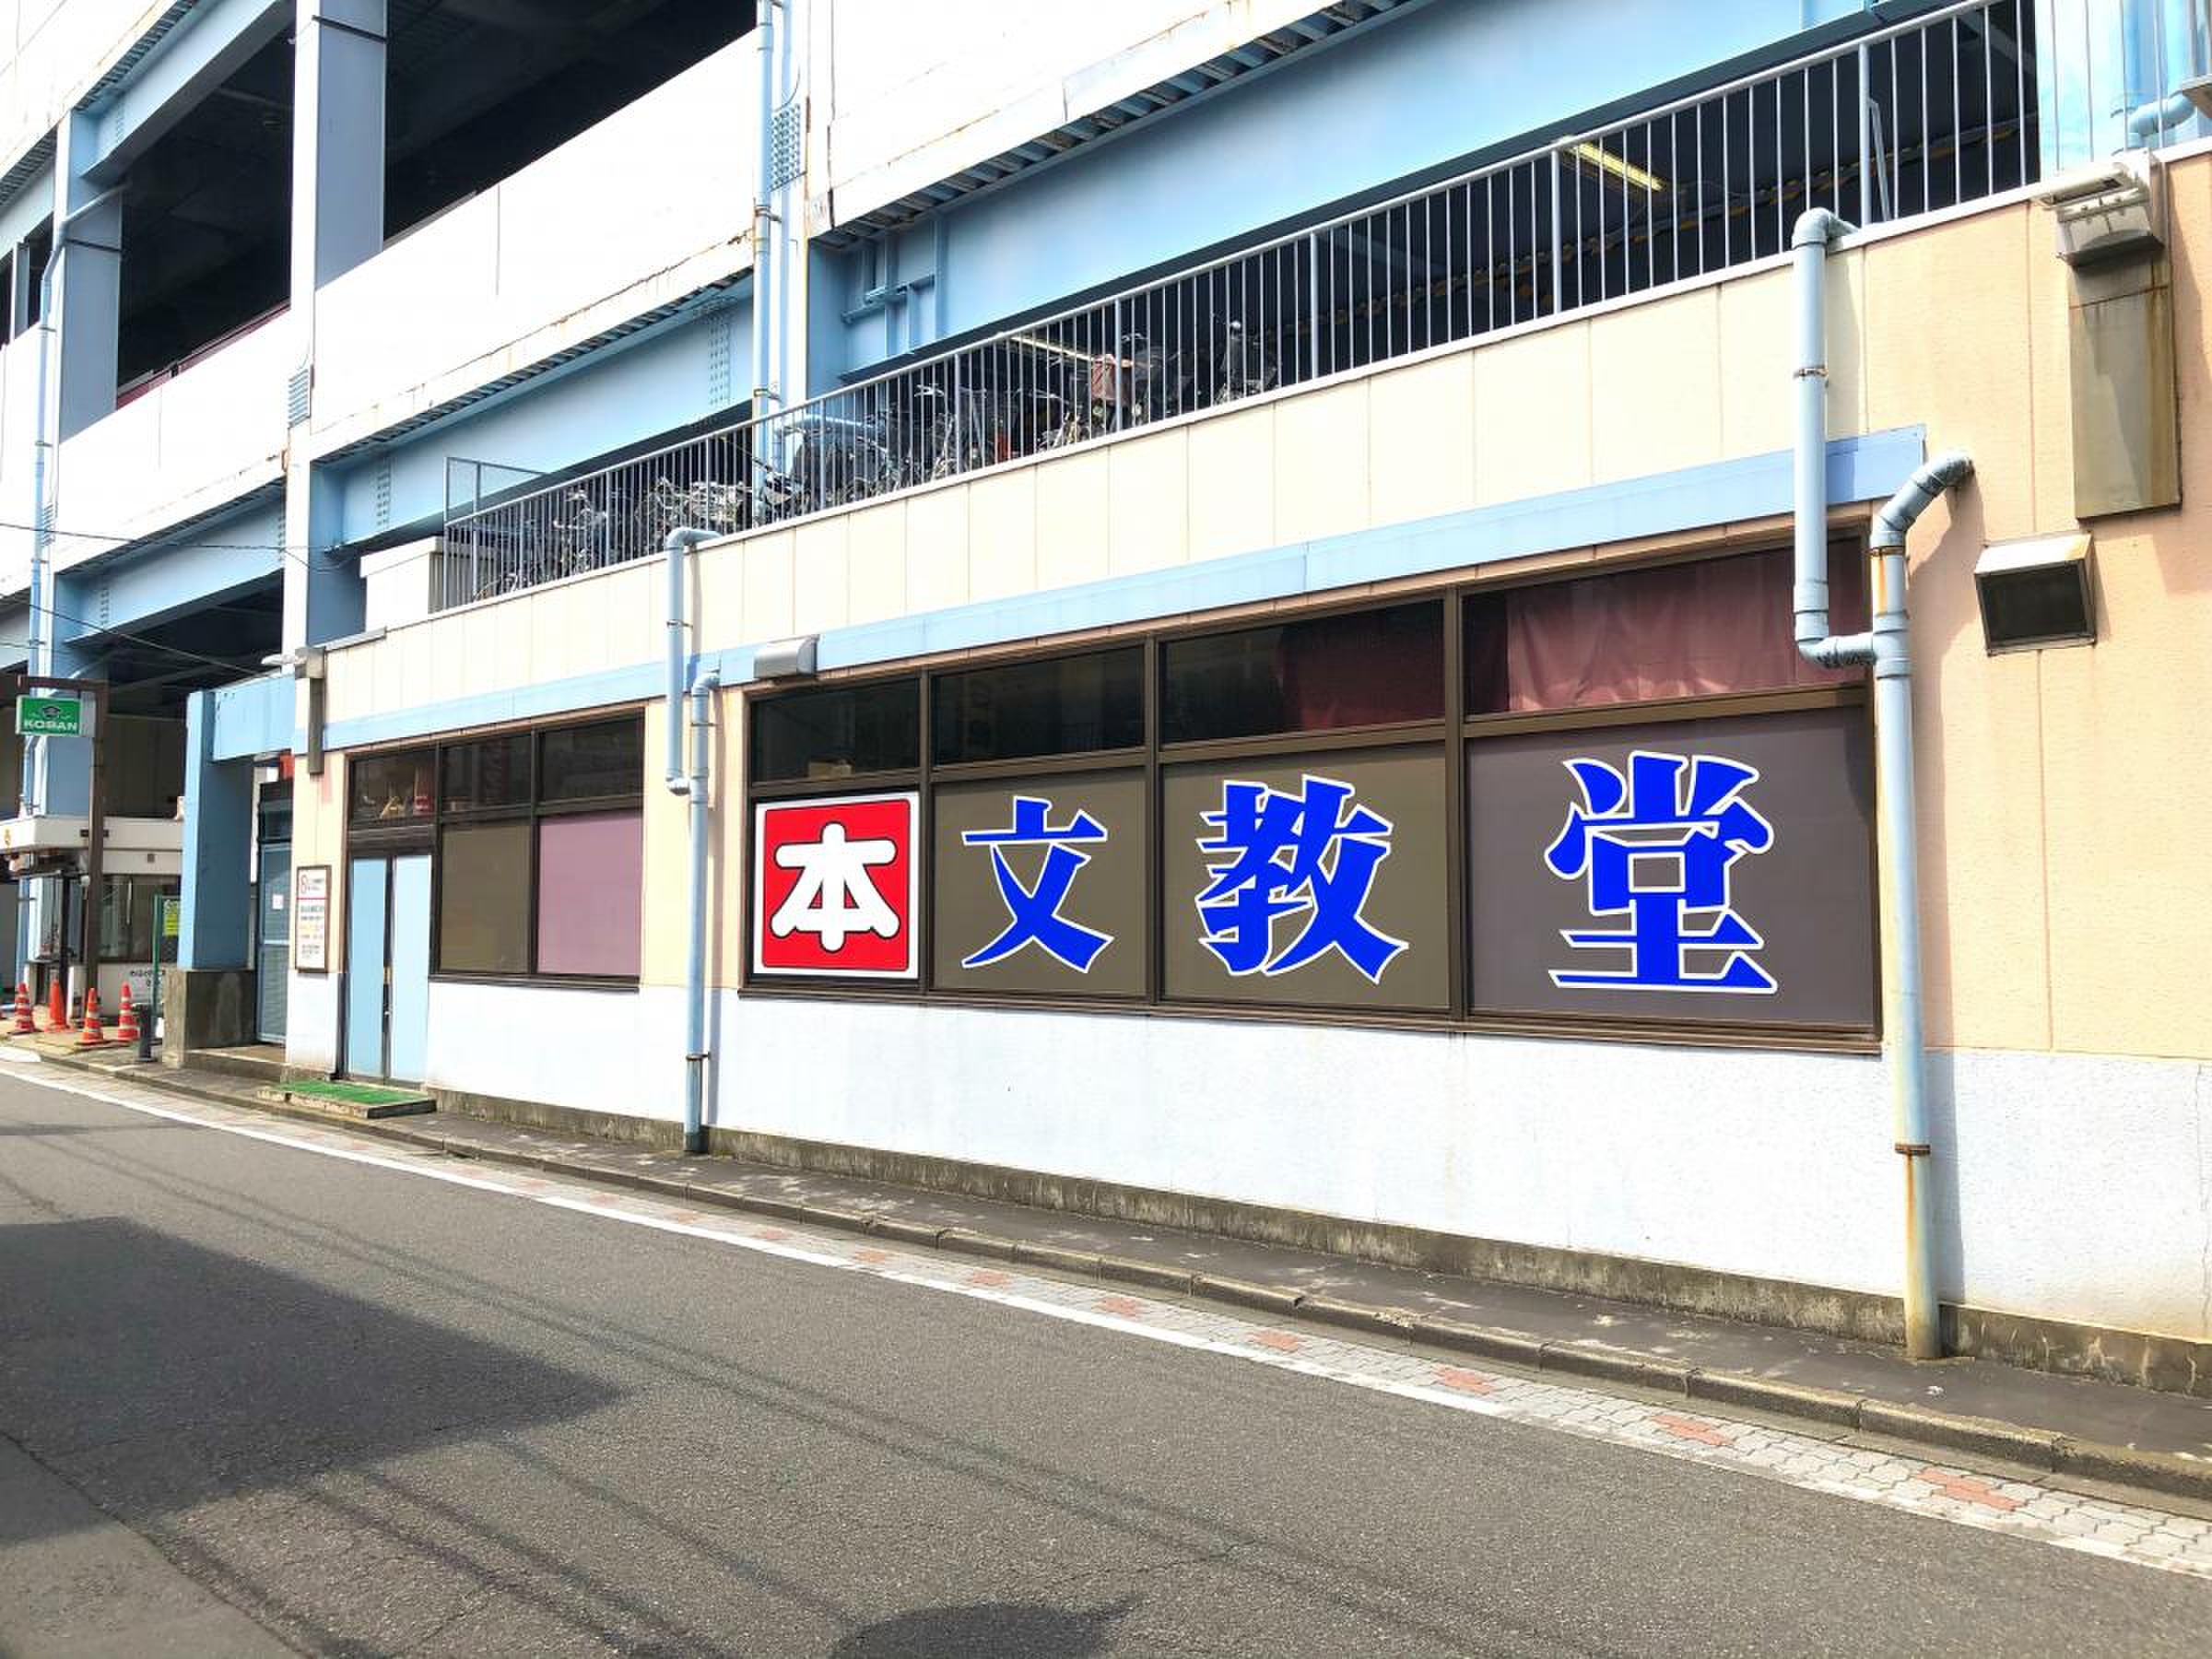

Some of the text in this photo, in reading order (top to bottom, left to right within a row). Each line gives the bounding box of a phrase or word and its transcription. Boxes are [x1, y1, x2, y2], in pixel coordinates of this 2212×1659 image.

[24, 720, 77, 731] KOBAN
[771, 821, 900, 953] 本
[961, 750, 1779, 994] 文教堂
